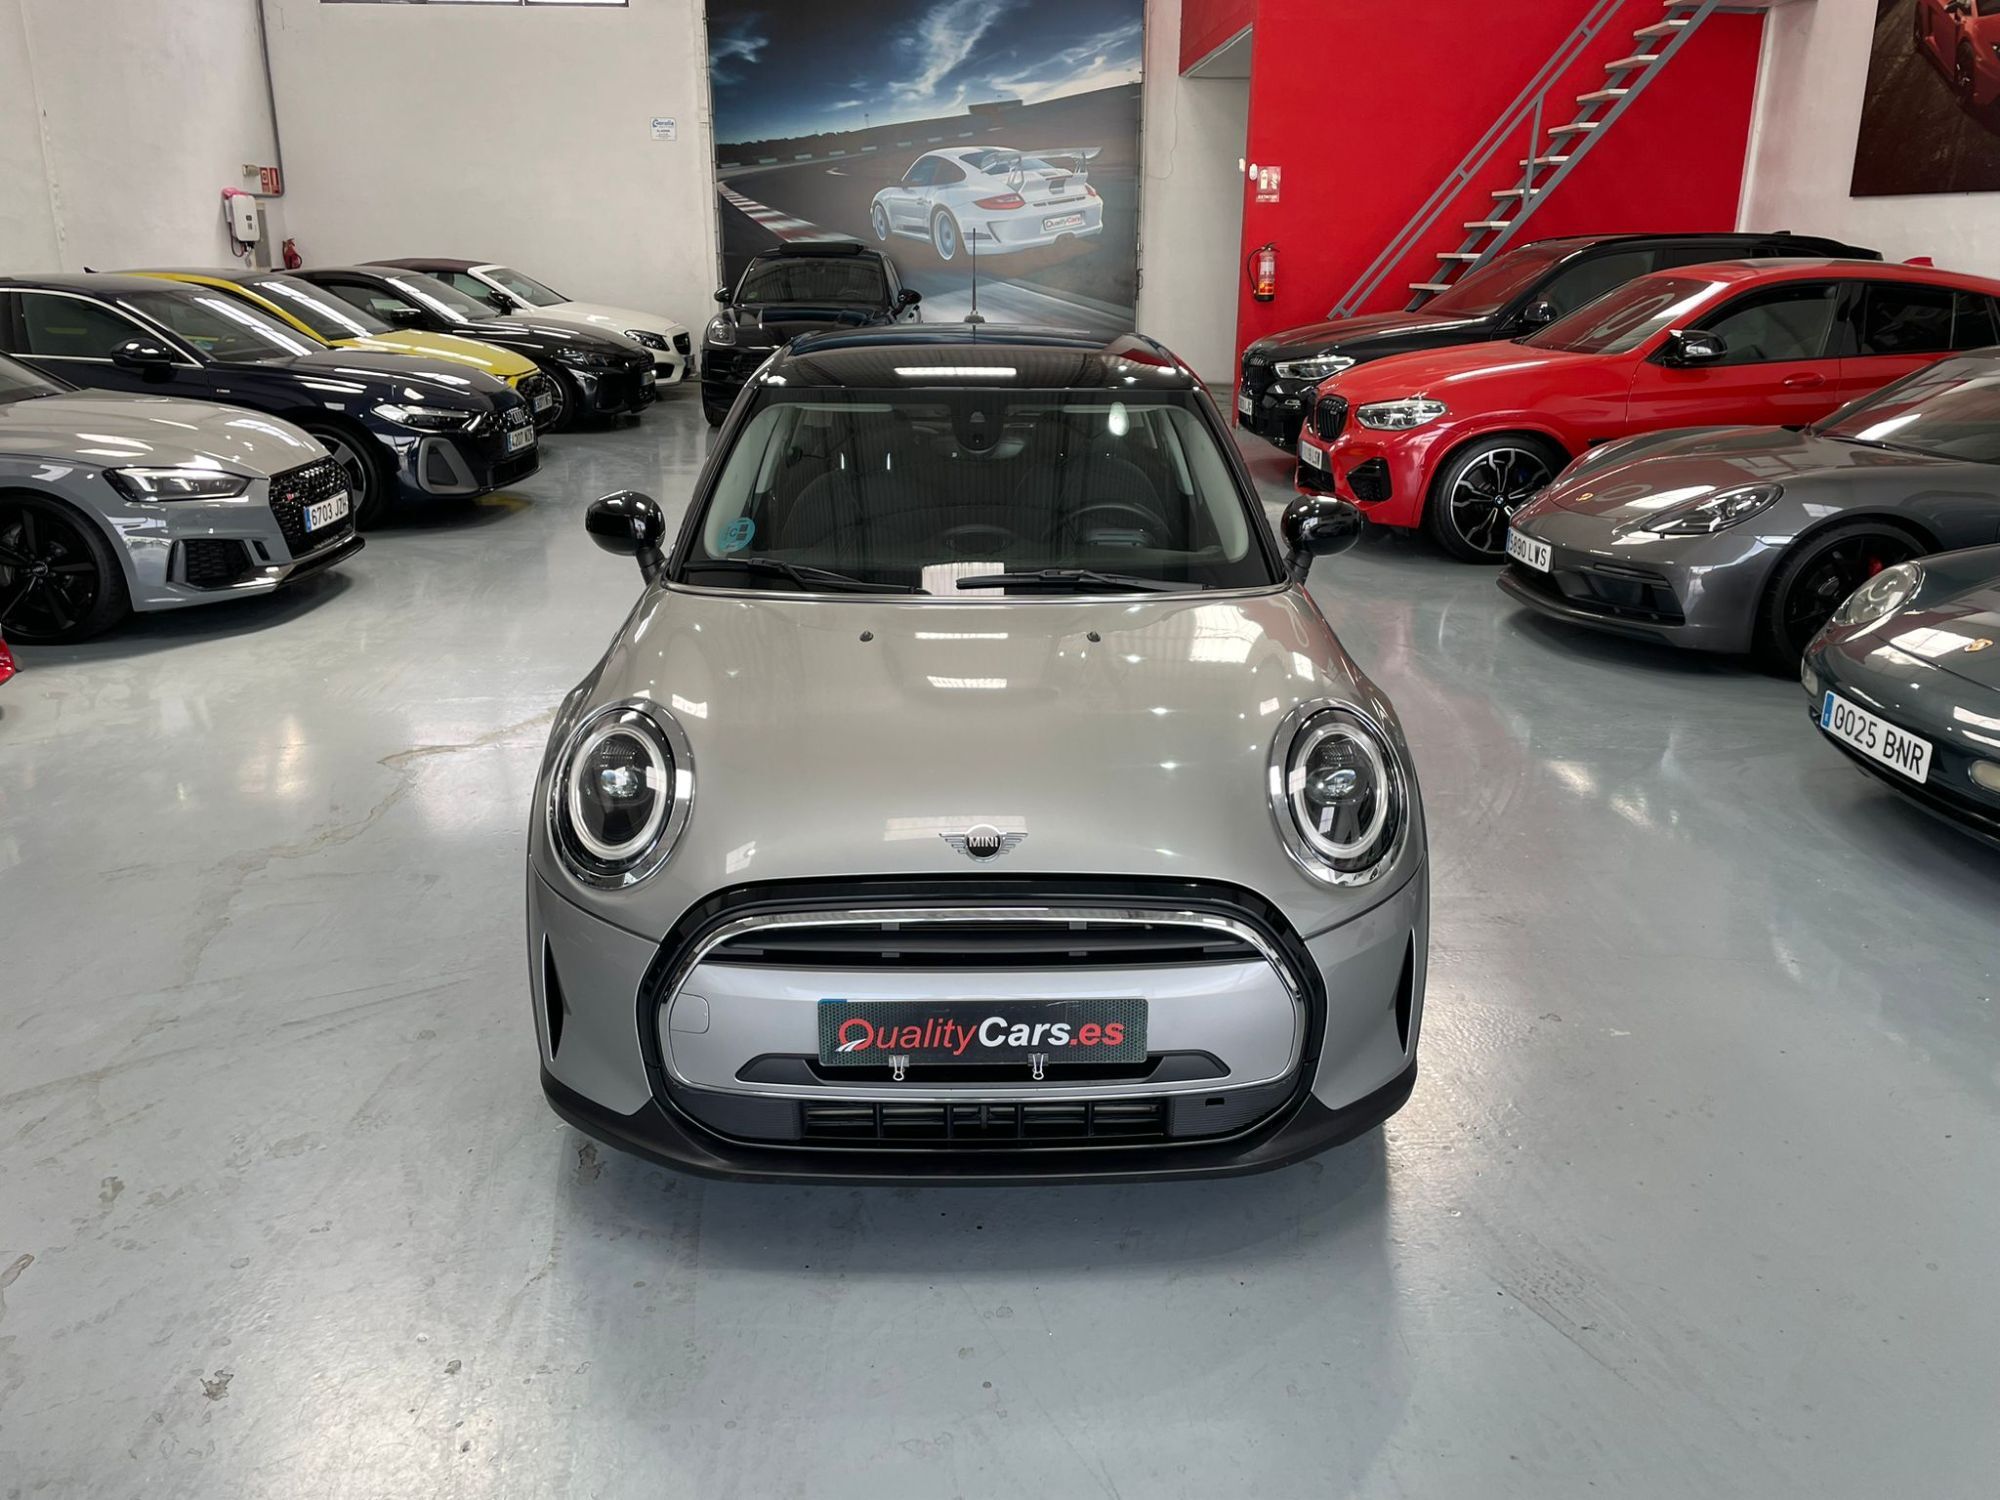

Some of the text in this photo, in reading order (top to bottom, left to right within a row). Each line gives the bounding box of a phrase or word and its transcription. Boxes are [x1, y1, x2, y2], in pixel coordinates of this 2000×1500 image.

[311, 502, 333, 526] 6703
[1834, 703, 1924, 775] 0025 BNR
[967, 836, 999, 848] MINI
[835, 1016, 1126, 1056] QualityCars.es
